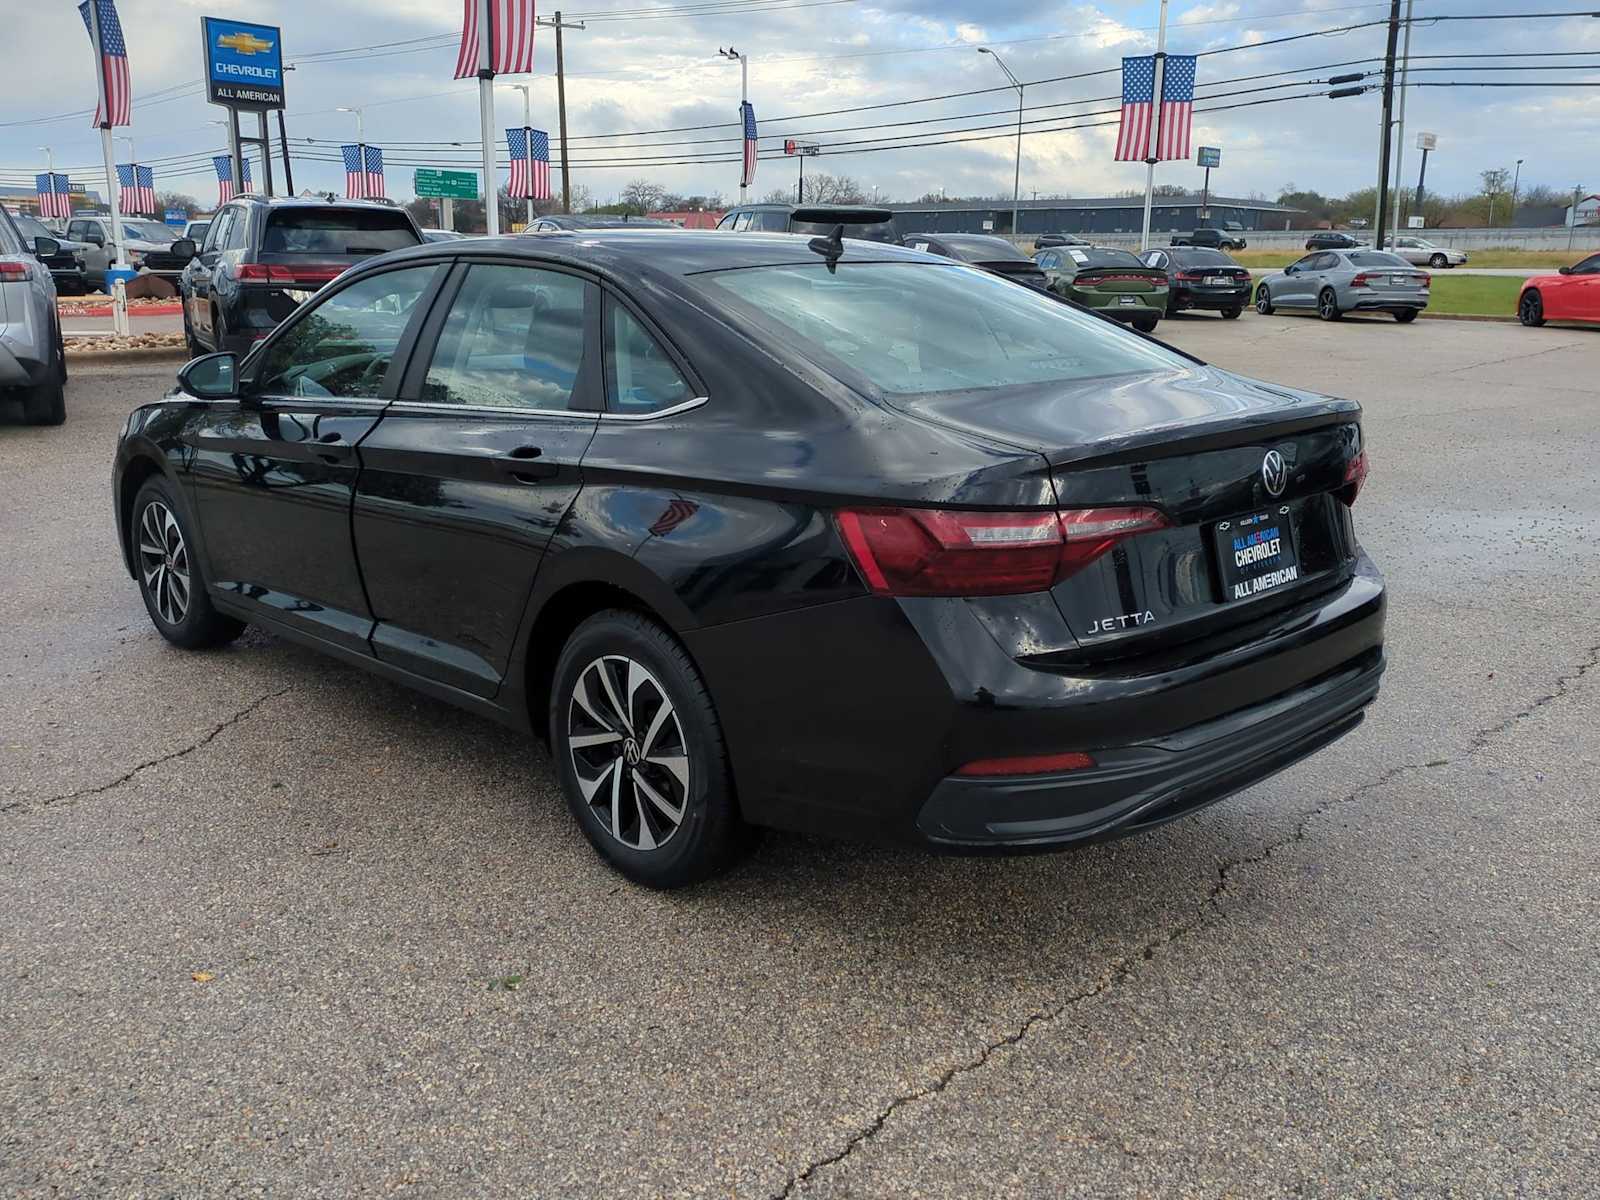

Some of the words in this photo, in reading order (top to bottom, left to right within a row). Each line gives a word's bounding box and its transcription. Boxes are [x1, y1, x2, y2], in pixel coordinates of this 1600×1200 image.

[216, 63, 277, 78] CHEVROLET
[217, 87, 234, 98] ALL
[236, 90, 280, 102] AMERICAN
[1233, 536, 1248, 550] ALL
[1247, 527, 1281, 547] AMERICAN
[1235, 538, 1281, 568] CHEVROLET
[1234, 581, 1252, 600] ALL
[1252, 565, 1299, 594] AMERICAN
[1087, 609, 1157, 635] JETTA
